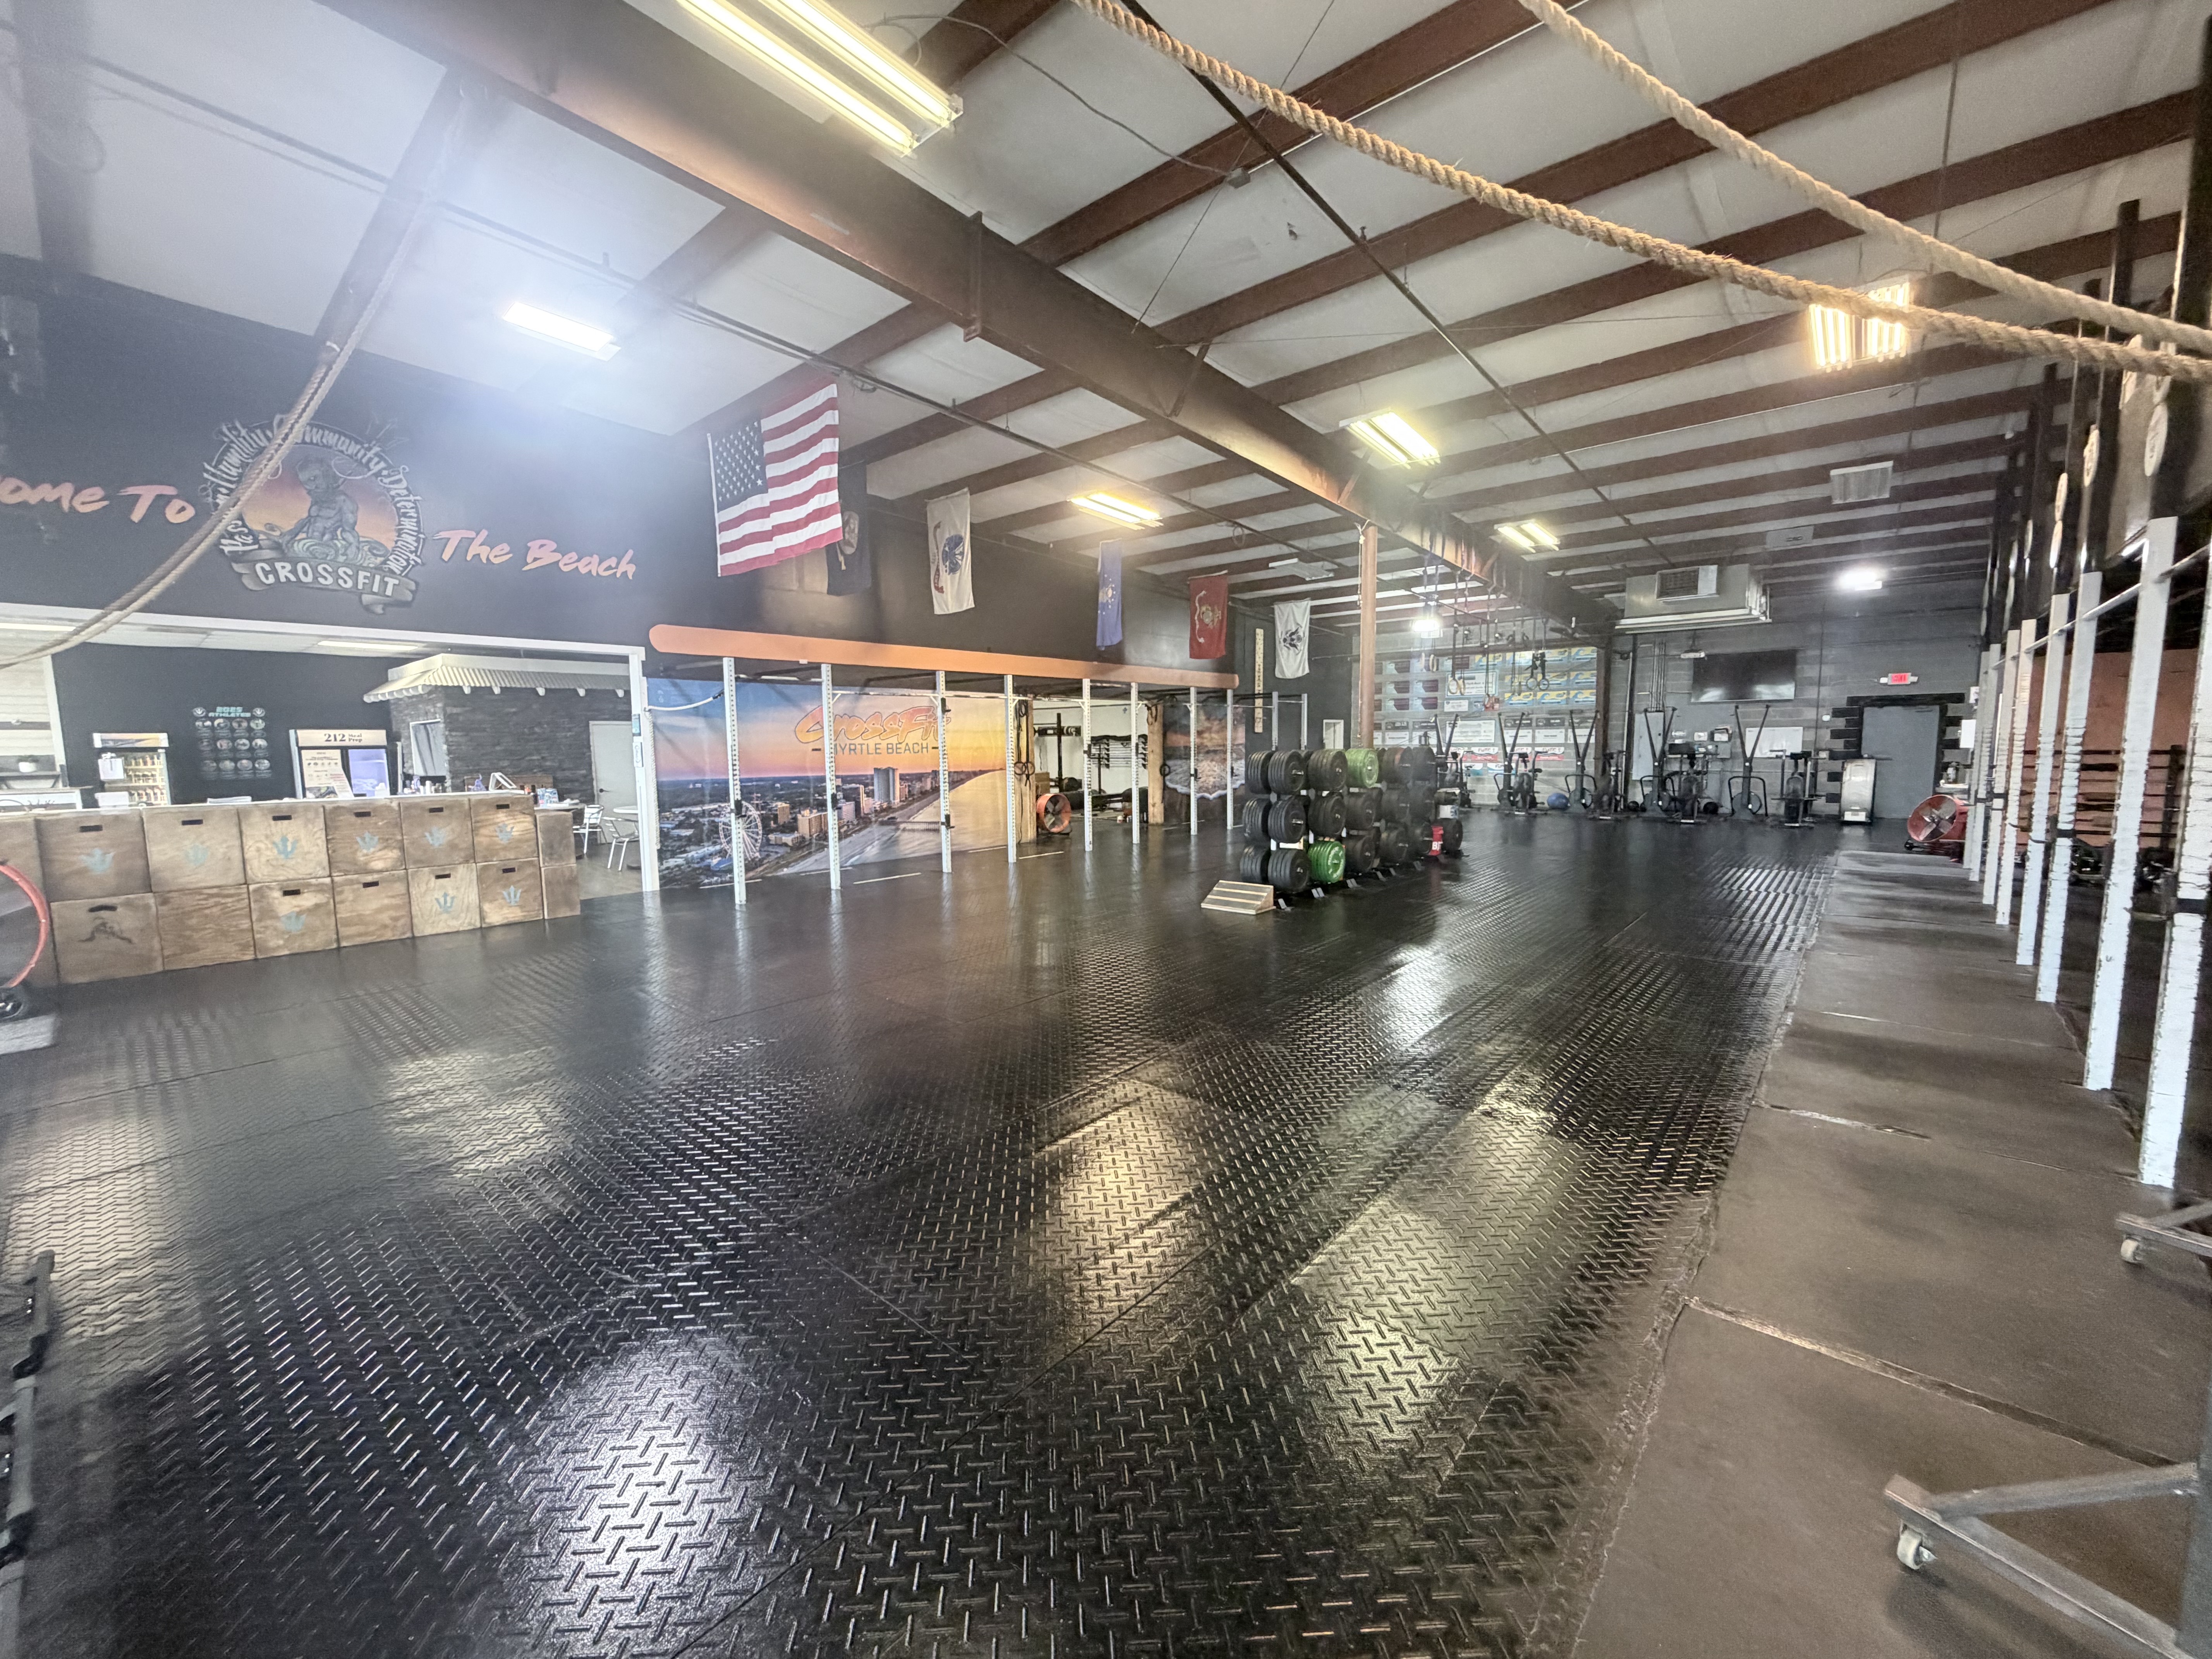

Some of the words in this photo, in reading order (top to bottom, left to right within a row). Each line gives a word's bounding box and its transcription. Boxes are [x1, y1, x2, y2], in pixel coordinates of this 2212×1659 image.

[0, 477, 110, 513] ome
[117, 485, 196, 524] To
[378, 465, 426, 577] Determination
[433, 529, 513, 564] The
[522, 539, 636, 580] Beach
[255, 562, 399, 596] CROSSFIT
[324, 733, 346, 742] 212
[795, 705, 951, 743] CrossFi
[886, 742, 929, 754] BEACH
